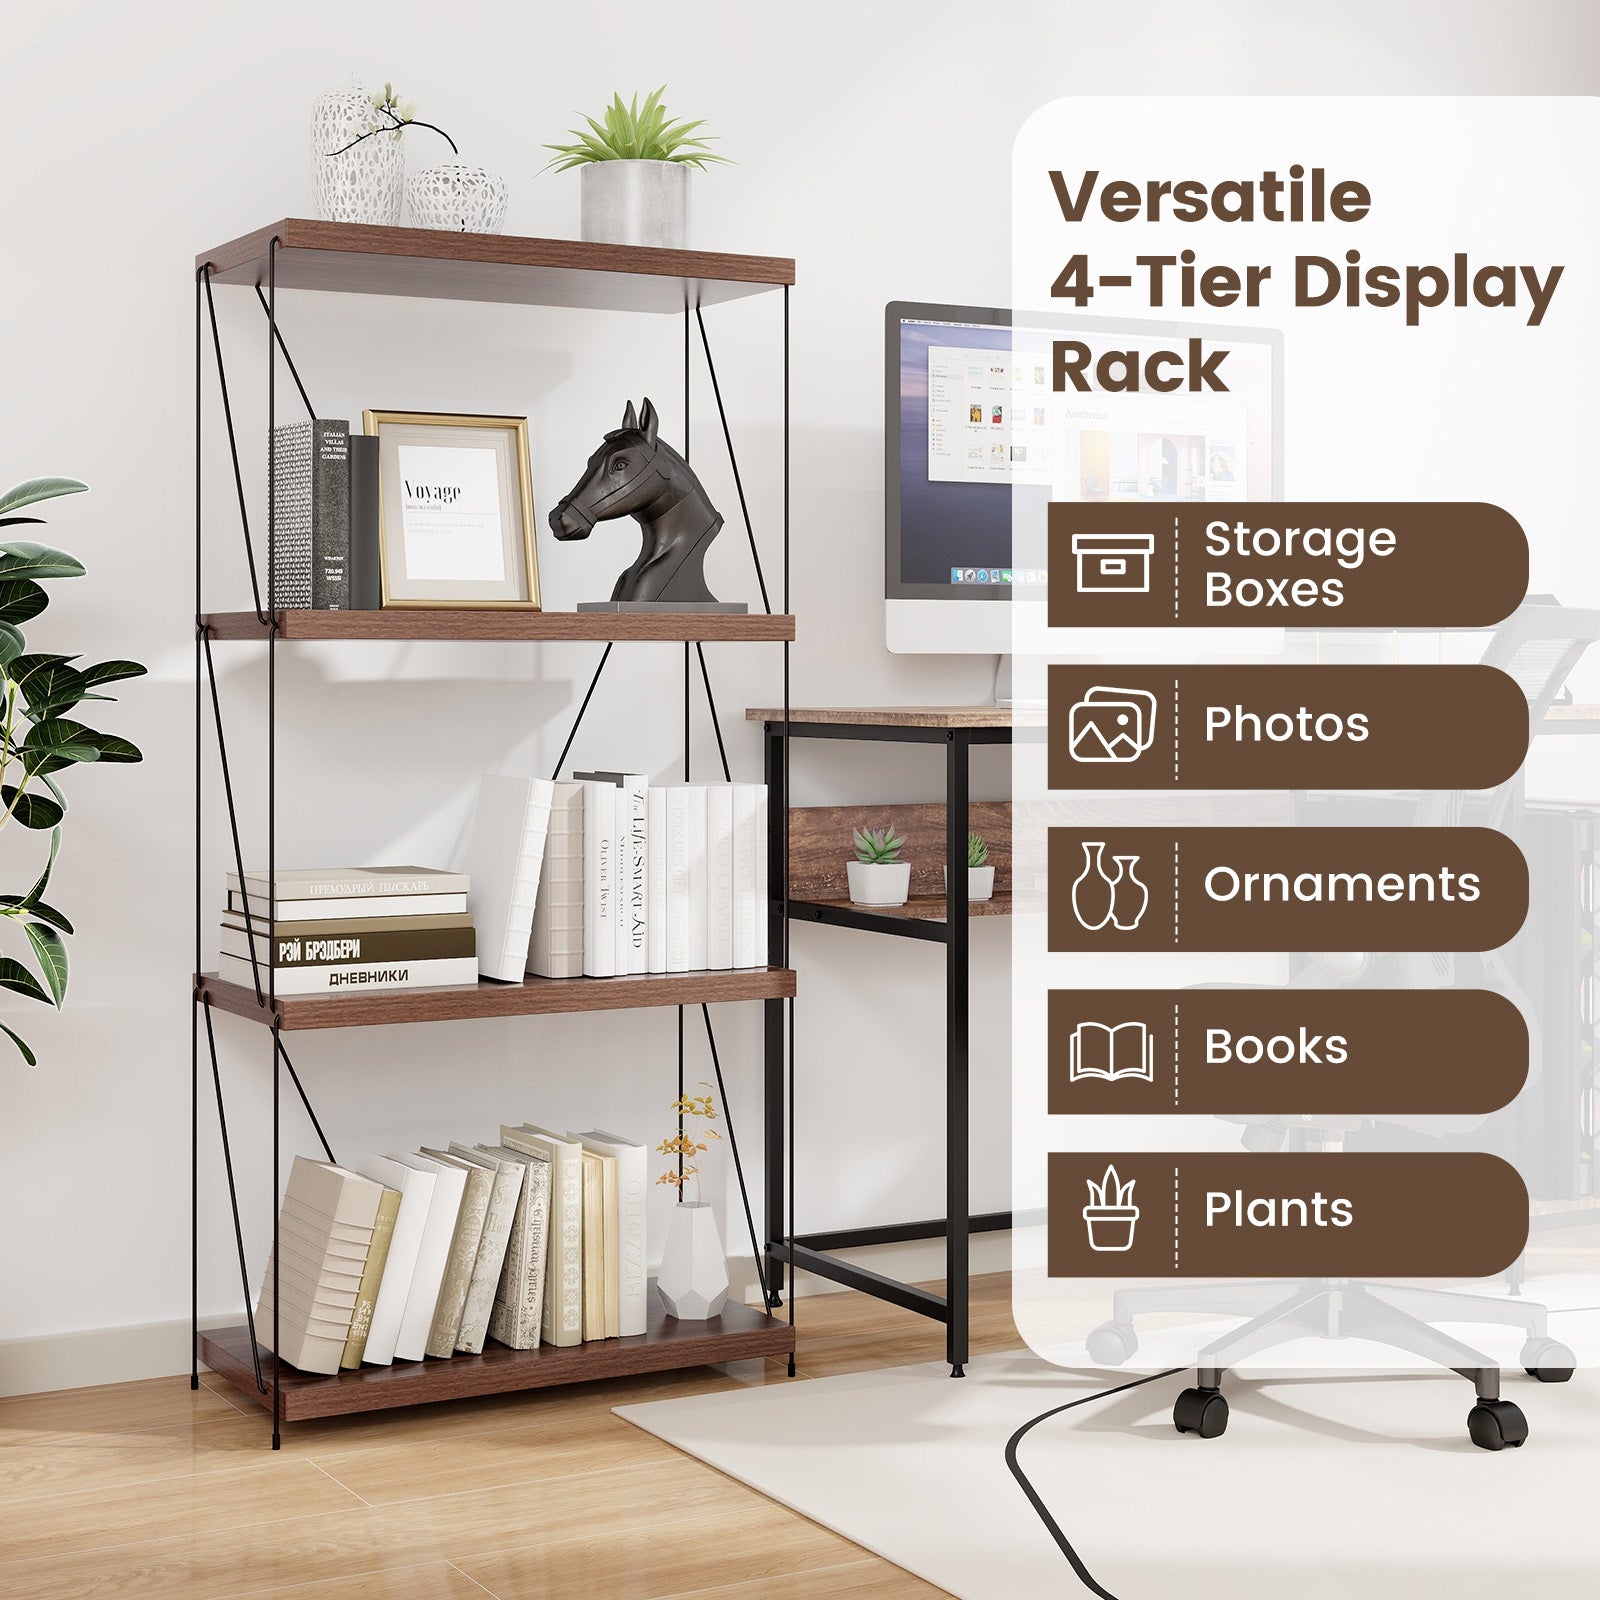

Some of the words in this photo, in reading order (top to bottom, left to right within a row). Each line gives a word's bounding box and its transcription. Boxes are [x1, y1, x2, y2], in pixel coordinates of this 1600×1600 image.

[404, 479, 461, 504] Voyage
[309, 881, 375, 896] ПРЕМУДРЫЙ
[278, 937, 301, 962] РЭЙ
[305, 938, 361, 961] БРЭДБЕРИ
[329, 969, 409, 986] ДНЕВНИКИ
